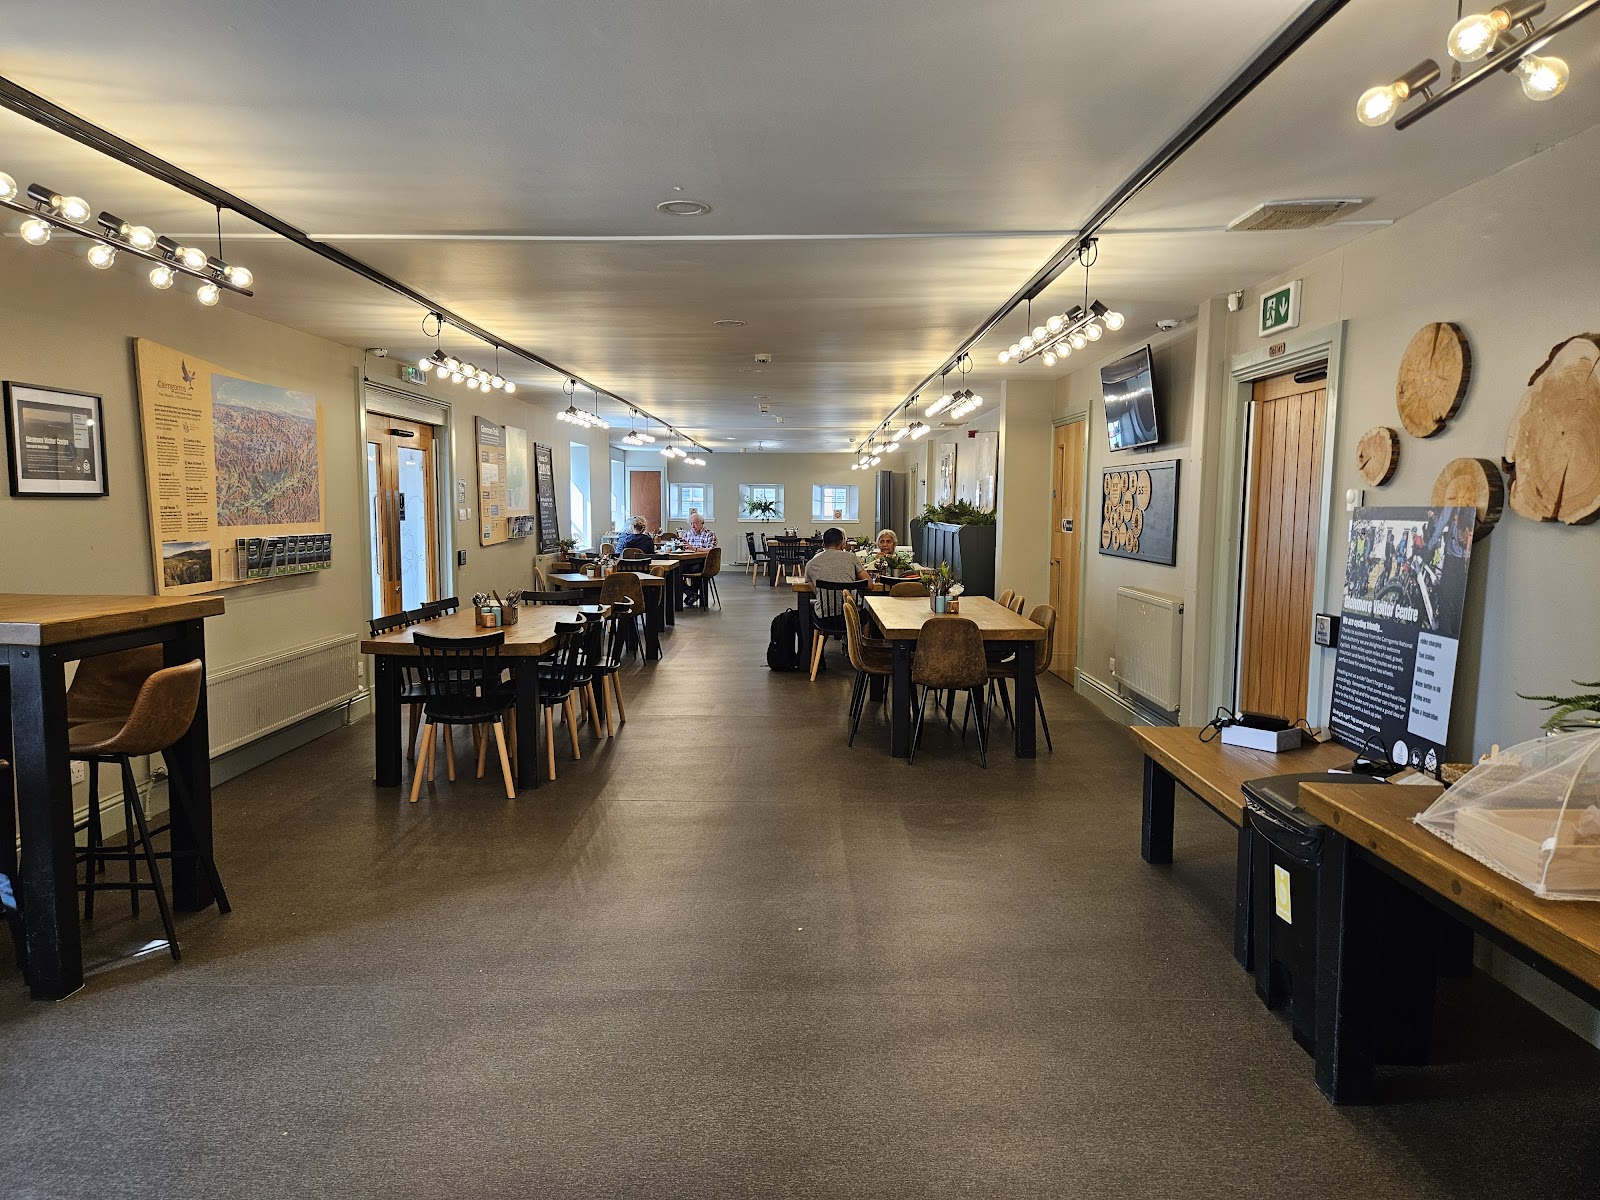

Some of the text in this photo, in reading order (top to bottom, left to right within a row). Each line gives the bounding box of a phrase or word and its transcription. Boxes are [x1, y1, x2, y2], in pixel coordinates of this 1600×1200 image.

[158, 380, 187, 393] Cairngorms
[1344, 595, 1419, 622] Glenmore Visitor Centre
[1343, 616, 1348, 624] We
[1354, 619, 1367, 630] cycling
[1382, 637, 1398, 646] Cairngorms
